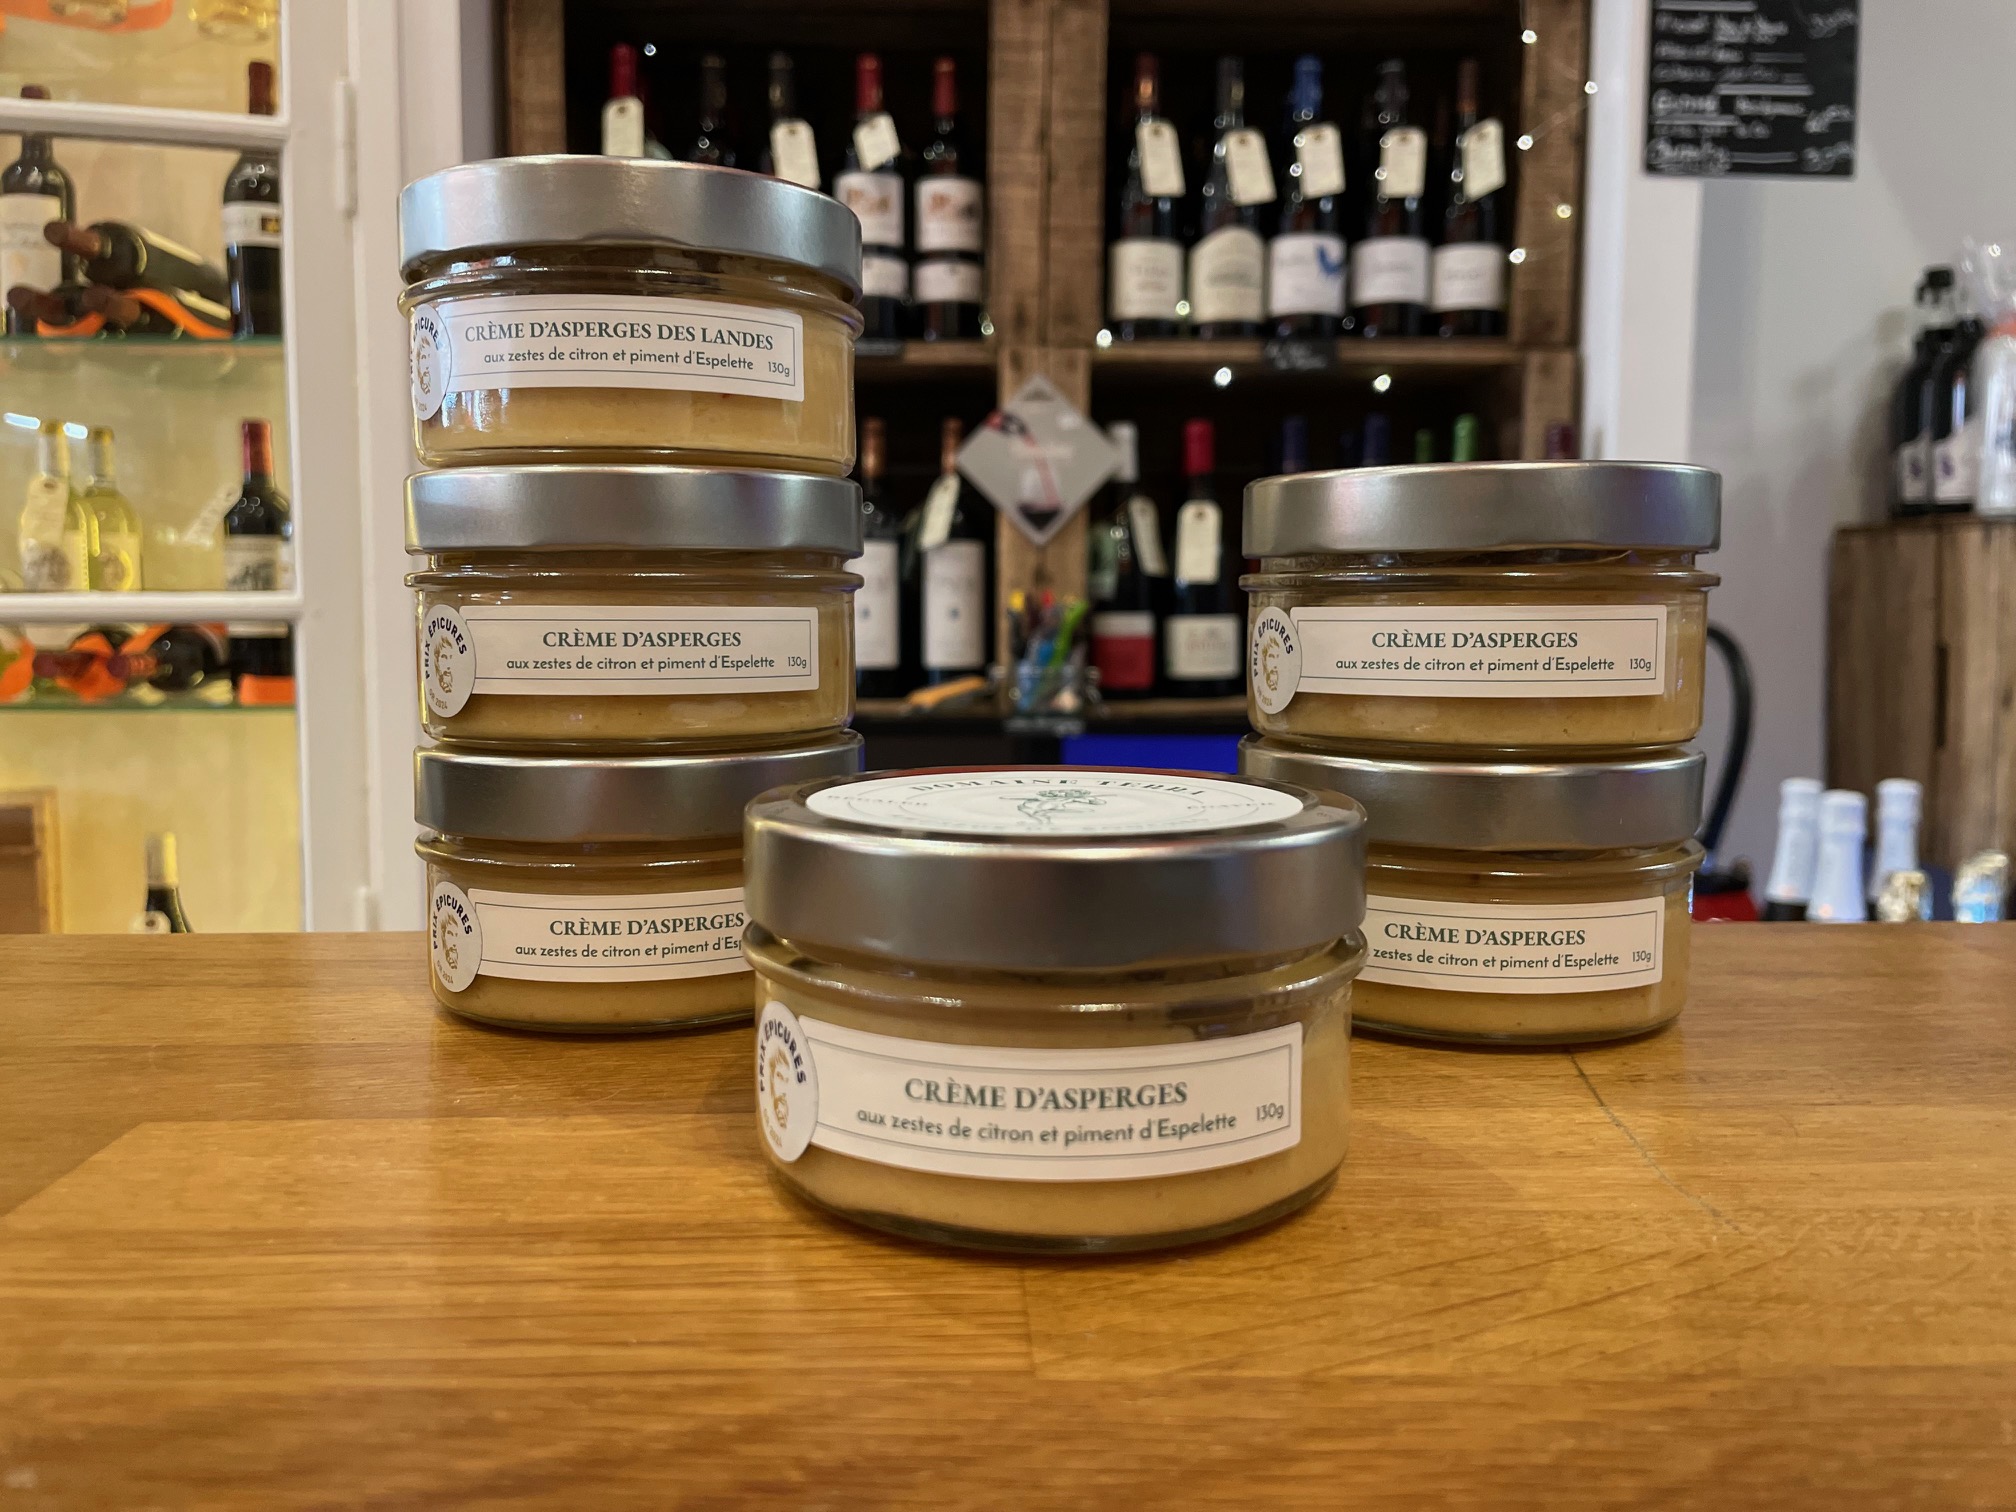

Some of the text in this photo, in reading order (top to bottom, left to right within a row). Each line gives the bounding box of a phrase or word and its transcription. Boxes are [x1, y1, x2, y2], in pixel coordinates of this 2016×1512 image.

[465, 321, 773, 351] CRÈME D'ASPERGES DES LANDES
[484, 347, 754, 370] aux zestes de citron et piment d'Espelette
[768, 361, 790, 377] 130g
[542, 629, 742, 648] CRÈME D'ASPERGES
[1371, 629, 1578, 649] CRÈME D'ASPERGES
[507, 654, 775, 673] aux zestes de citron et piment d'Espelette
[787, 657, 807, 670] 130g
[1335, 656, 1615, 674] aux zestes de citron et piment d'Espelette
[1629, 658, 1651, 672] 130g
[549, 912, 744, 936] CRÈME D'ASPERGES
[1384, 922, 1586, 946] CRÈME D'ASPERGES
[515, 945, 537, 956] aux
[540, 944, 578, 957] zestes
[581, 943, 598, 958] de
[601, 943, 641, 958] citron
[644, 943, 658, 957] et
[661, 939, 709, 958] piment
[1632, 950, 1652, 964] 130g
[1373, 948, 1413, 963] zestes
[1416, 949, 1434, 964] de
[1437, 952, 1479, 967] citron
[1482, 955, 1497, 968] et
[1500, 956, 1549, 971] piment
[1552, 952, 1619, 970] d'Espelette
[905, 1078, 1188, 1111] CRÈME D'ASPERGES
[1255, 1103, 1285, 1123] 130g
[857, 1110, 1237, 1148] aux zestes de citron et piment d'Espelette
